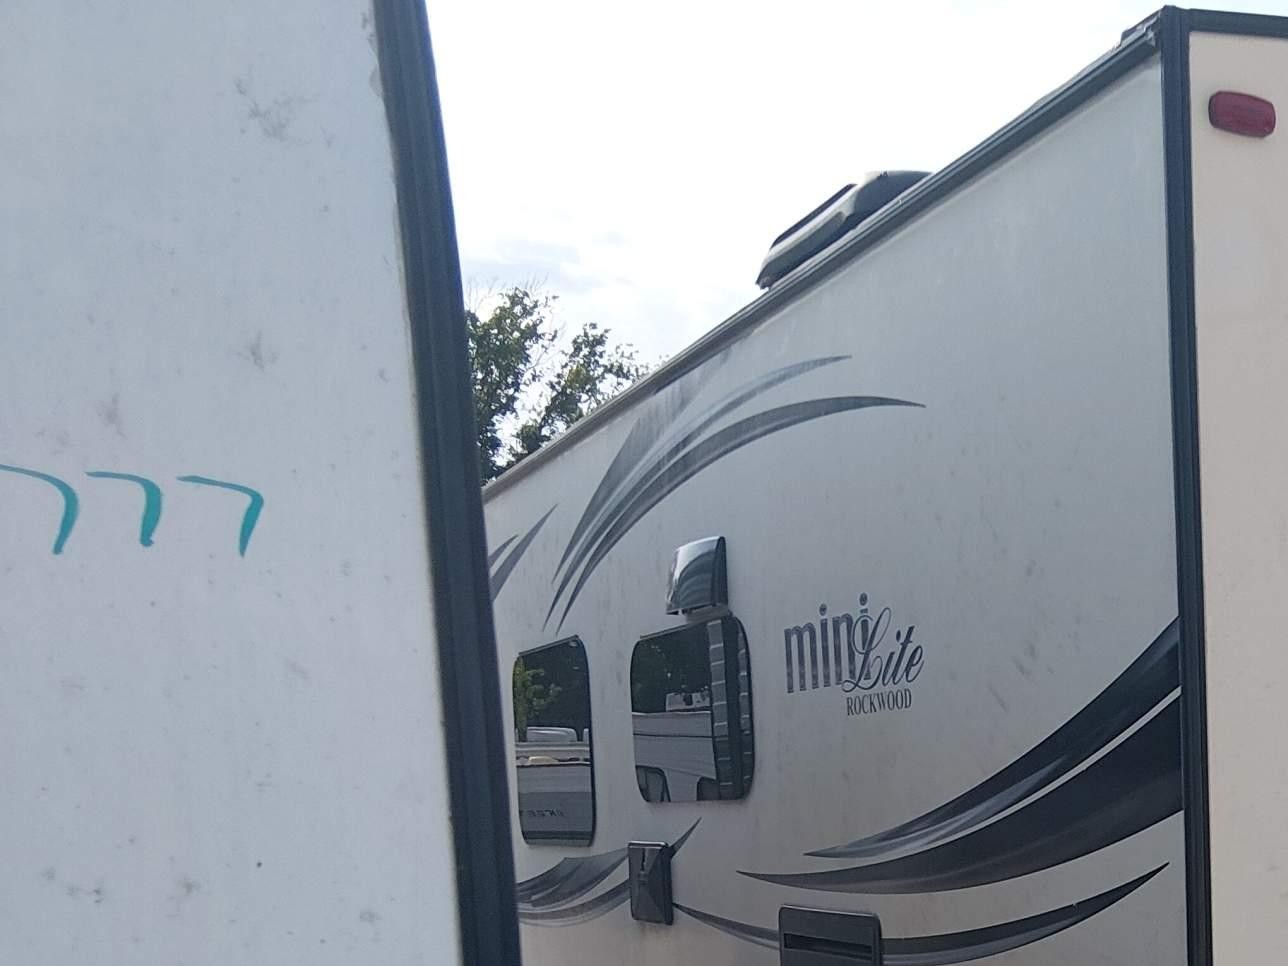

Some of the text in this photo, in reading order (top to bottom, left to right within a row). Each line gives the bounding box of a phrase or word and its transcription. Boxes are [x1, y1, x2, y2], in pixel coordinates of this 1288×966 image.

[784, 592, 925, 694] mini Lite
[846, 688, 912, 716] ROCKWOOD
